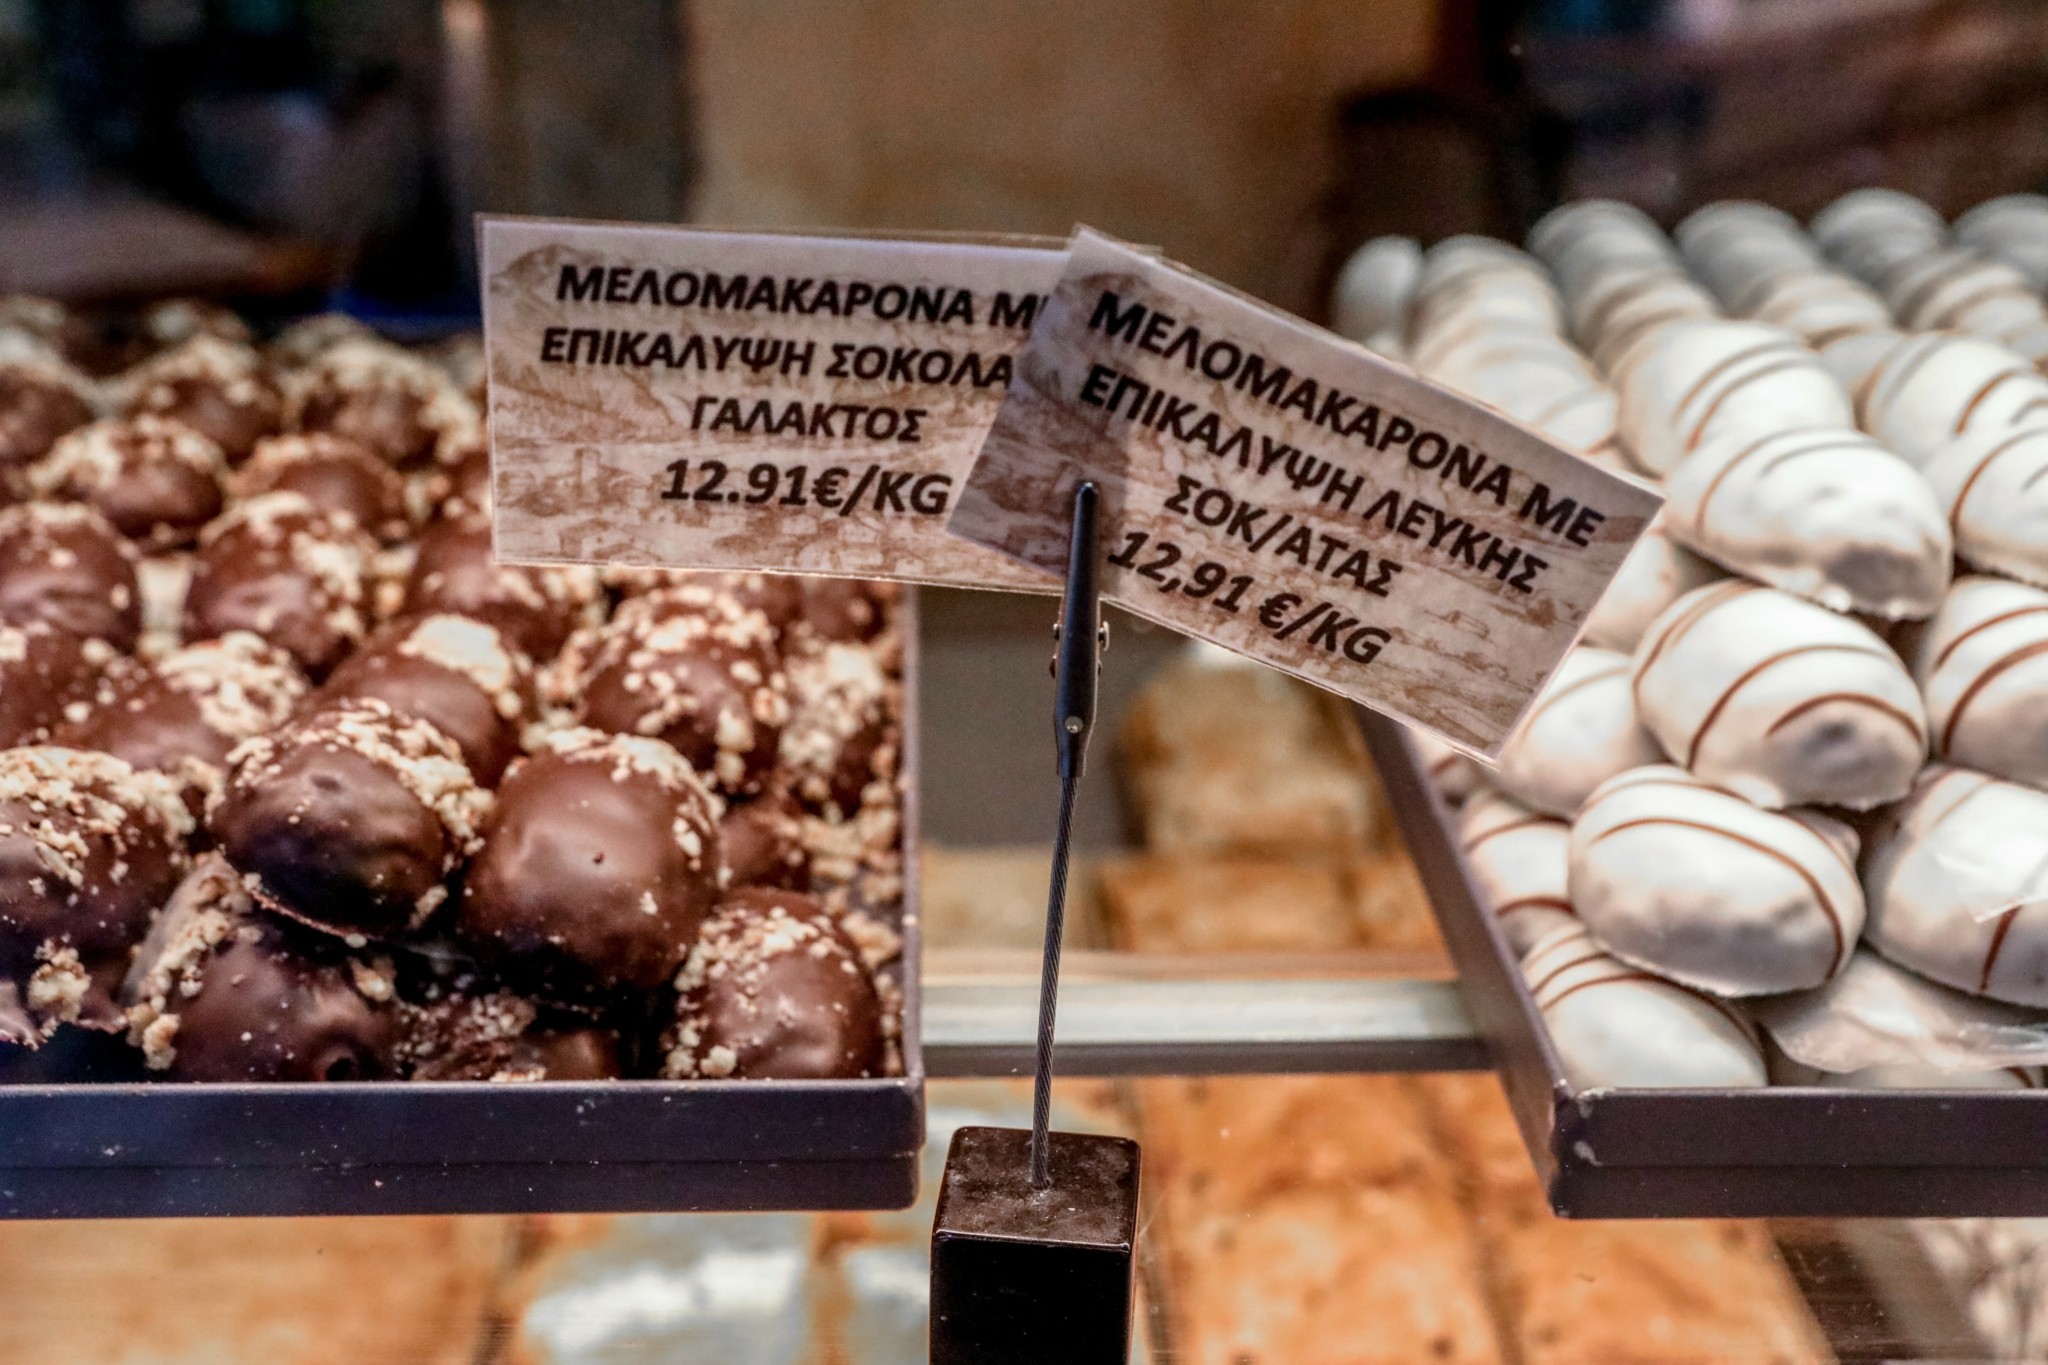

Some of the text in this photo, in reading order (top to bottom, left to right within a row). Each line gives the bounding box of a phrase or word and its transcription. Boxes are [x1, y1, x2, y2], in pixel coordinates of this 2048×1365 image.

[556, 264, 1049, 331] ΜΕΛΟΜΑΚΑΡΟΝΑ Μ
[540, 326, 813, 377] ΕΠΙΚΑΛΥΨΗ
[689, 396, 928, 443] ΓΑΛΑΚΤΟΣ
[1089, 291, 1607, 548] ΜΕΛΟΜΑΚΑΡΟΝΑ ΜΕ
[660, 459, 953, 517] 12.91€/KG
[1080, 363, 1549, 596] ΕΠΙΚΑΛΥΨΗ ΛΕΥΚΗΣ
[1163, 473, 1404, 599] ΣΟΚ/ΑΤΑΣ
[1107, 529, 1391, 666] 12,91 €/KG
